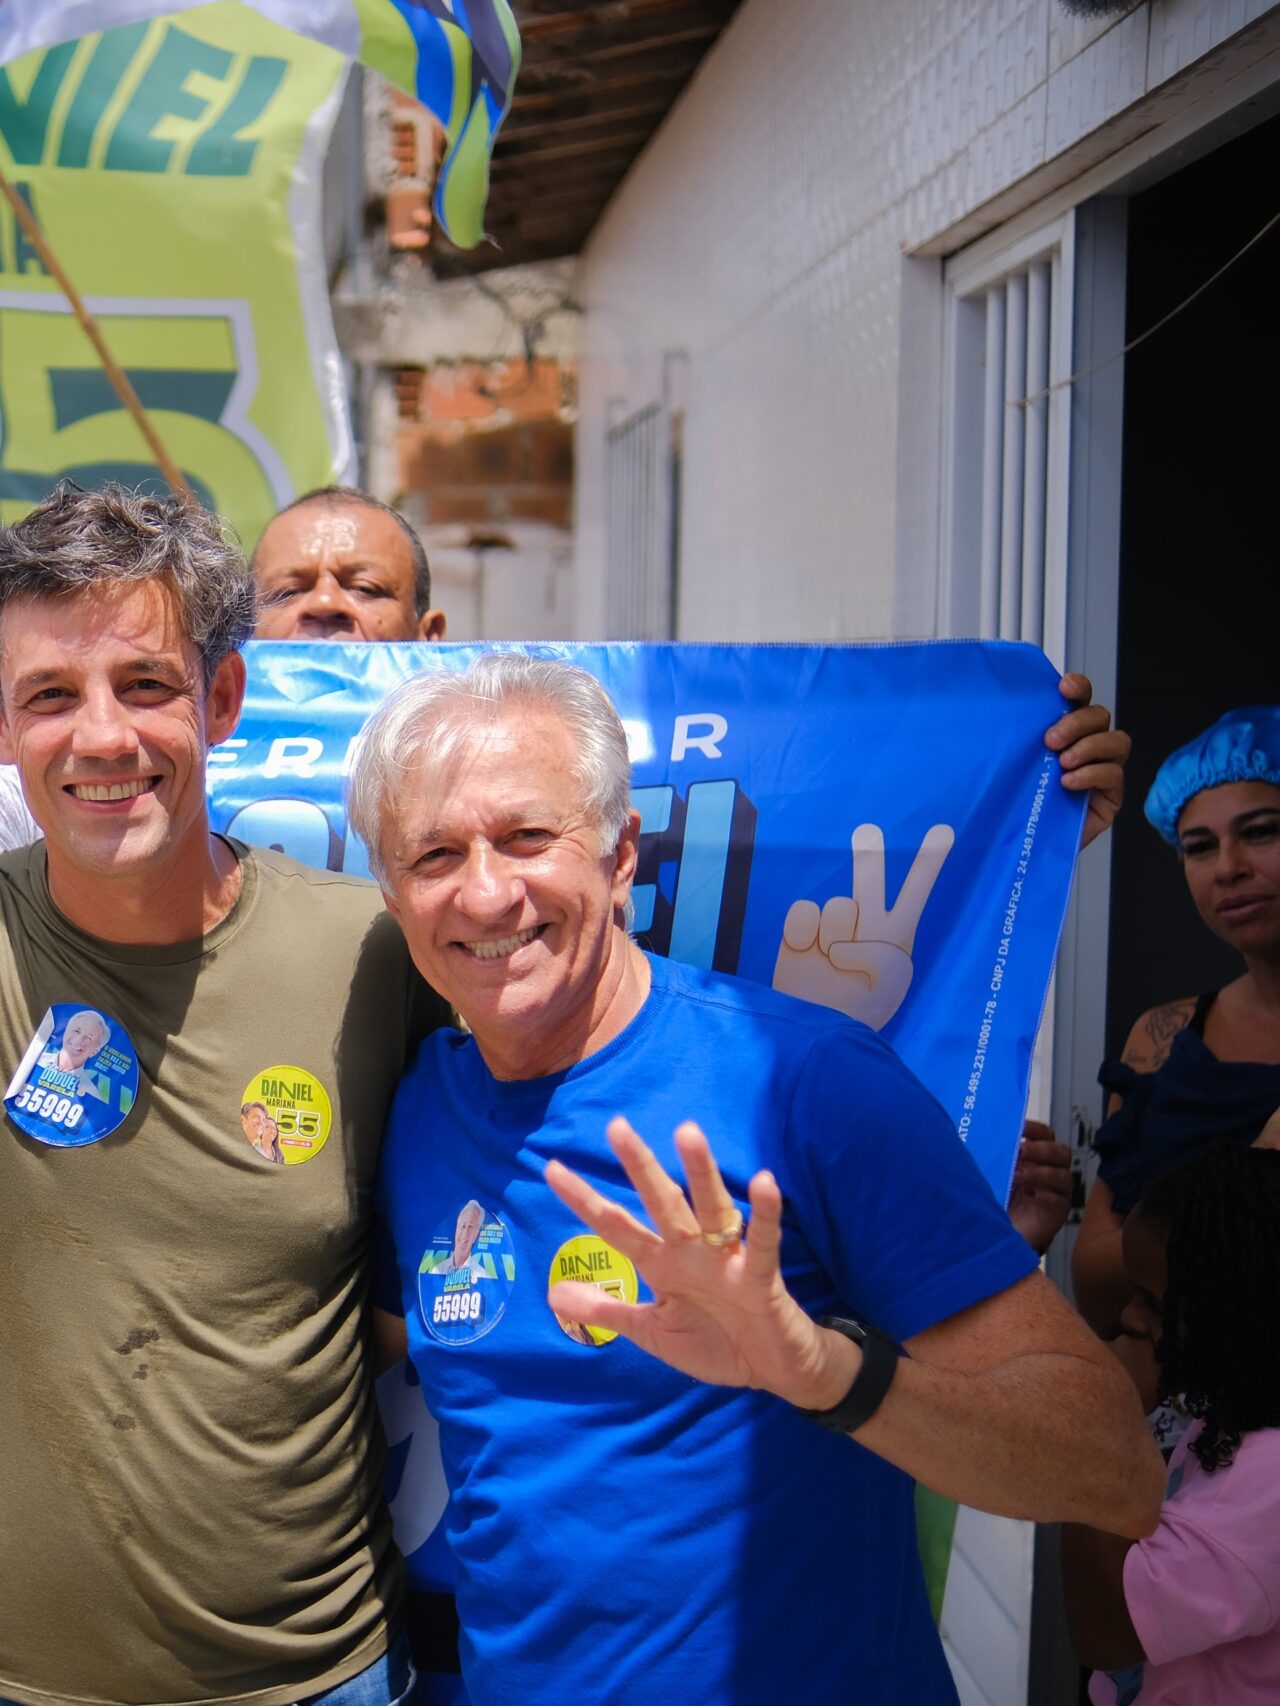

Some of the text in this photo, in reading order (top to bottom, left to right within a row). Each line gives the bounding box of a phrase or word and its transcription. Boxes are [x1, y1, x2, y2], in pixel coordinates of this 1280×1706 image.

[1003, 876, 1025, 936] GRÁFICA:
[999, 938, 1010, 955] DA
[991, 958, 1006, 991] CNPJ
[964, 1001, 998, 1110] 56.495.231/0001-78
[15, 1083, 84, 1128] 55999
[261, 1079, 314, 1102] DANIEL
[266, 1097, 295, 1109] MARIANA
[276, 1109, 320, 1138] 55
[560, 1250, 612, 1276] DANIEL
[433, 1292, 481, 1323] 55999
